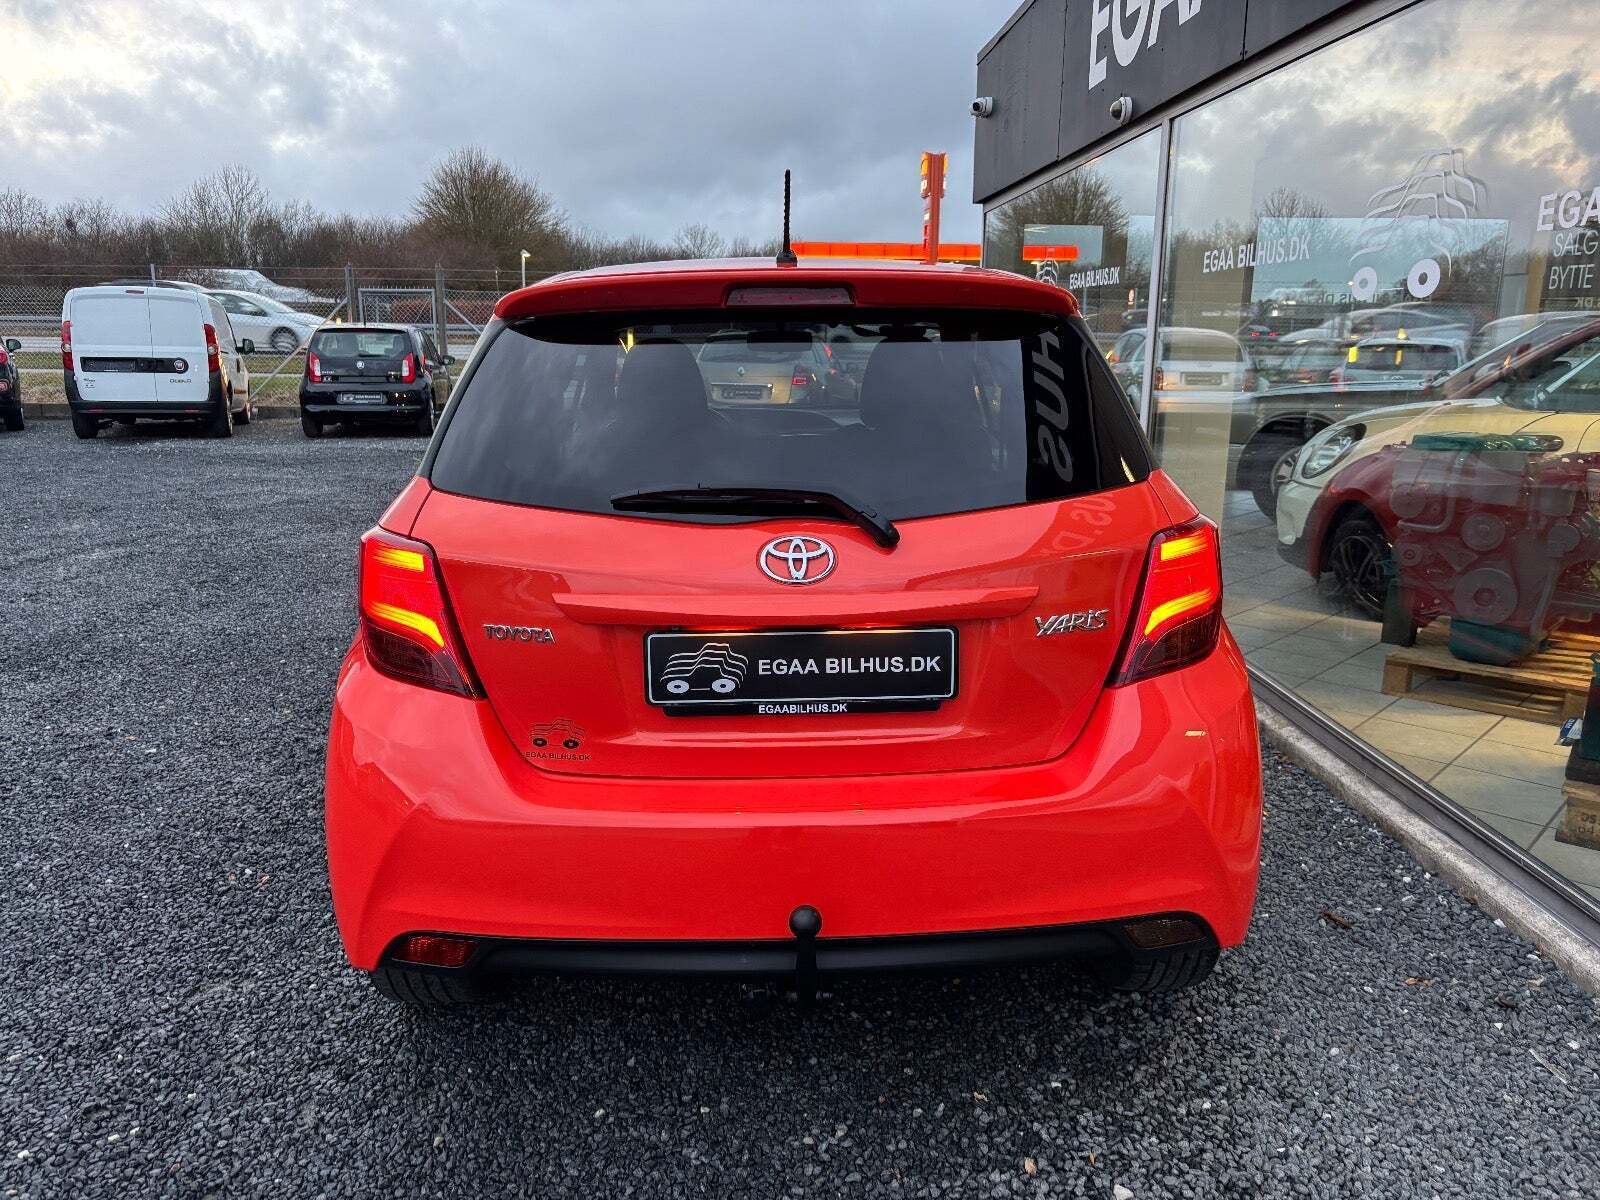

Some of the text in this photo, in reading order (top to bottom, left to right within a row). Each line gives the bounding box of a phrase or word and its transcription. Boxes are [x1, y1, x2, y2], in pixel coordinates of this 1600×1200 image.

[1553, 229, 1599, 257] SALG
[1203, 234, 1311, 273] EGAA BILHUS.DK
[1069, 272, 1085, 289] EGAA
[1548, 264, 1595, 290] BYTTE
[483, 623, 556, 644] TOYOTA
[758, 655, 942, 675] EGAA BILHUS.DK
[758, 703, 848, 714] EGAABILHUS.DK
[525, 751, 592, 761] EGAA BILHUS.DK
